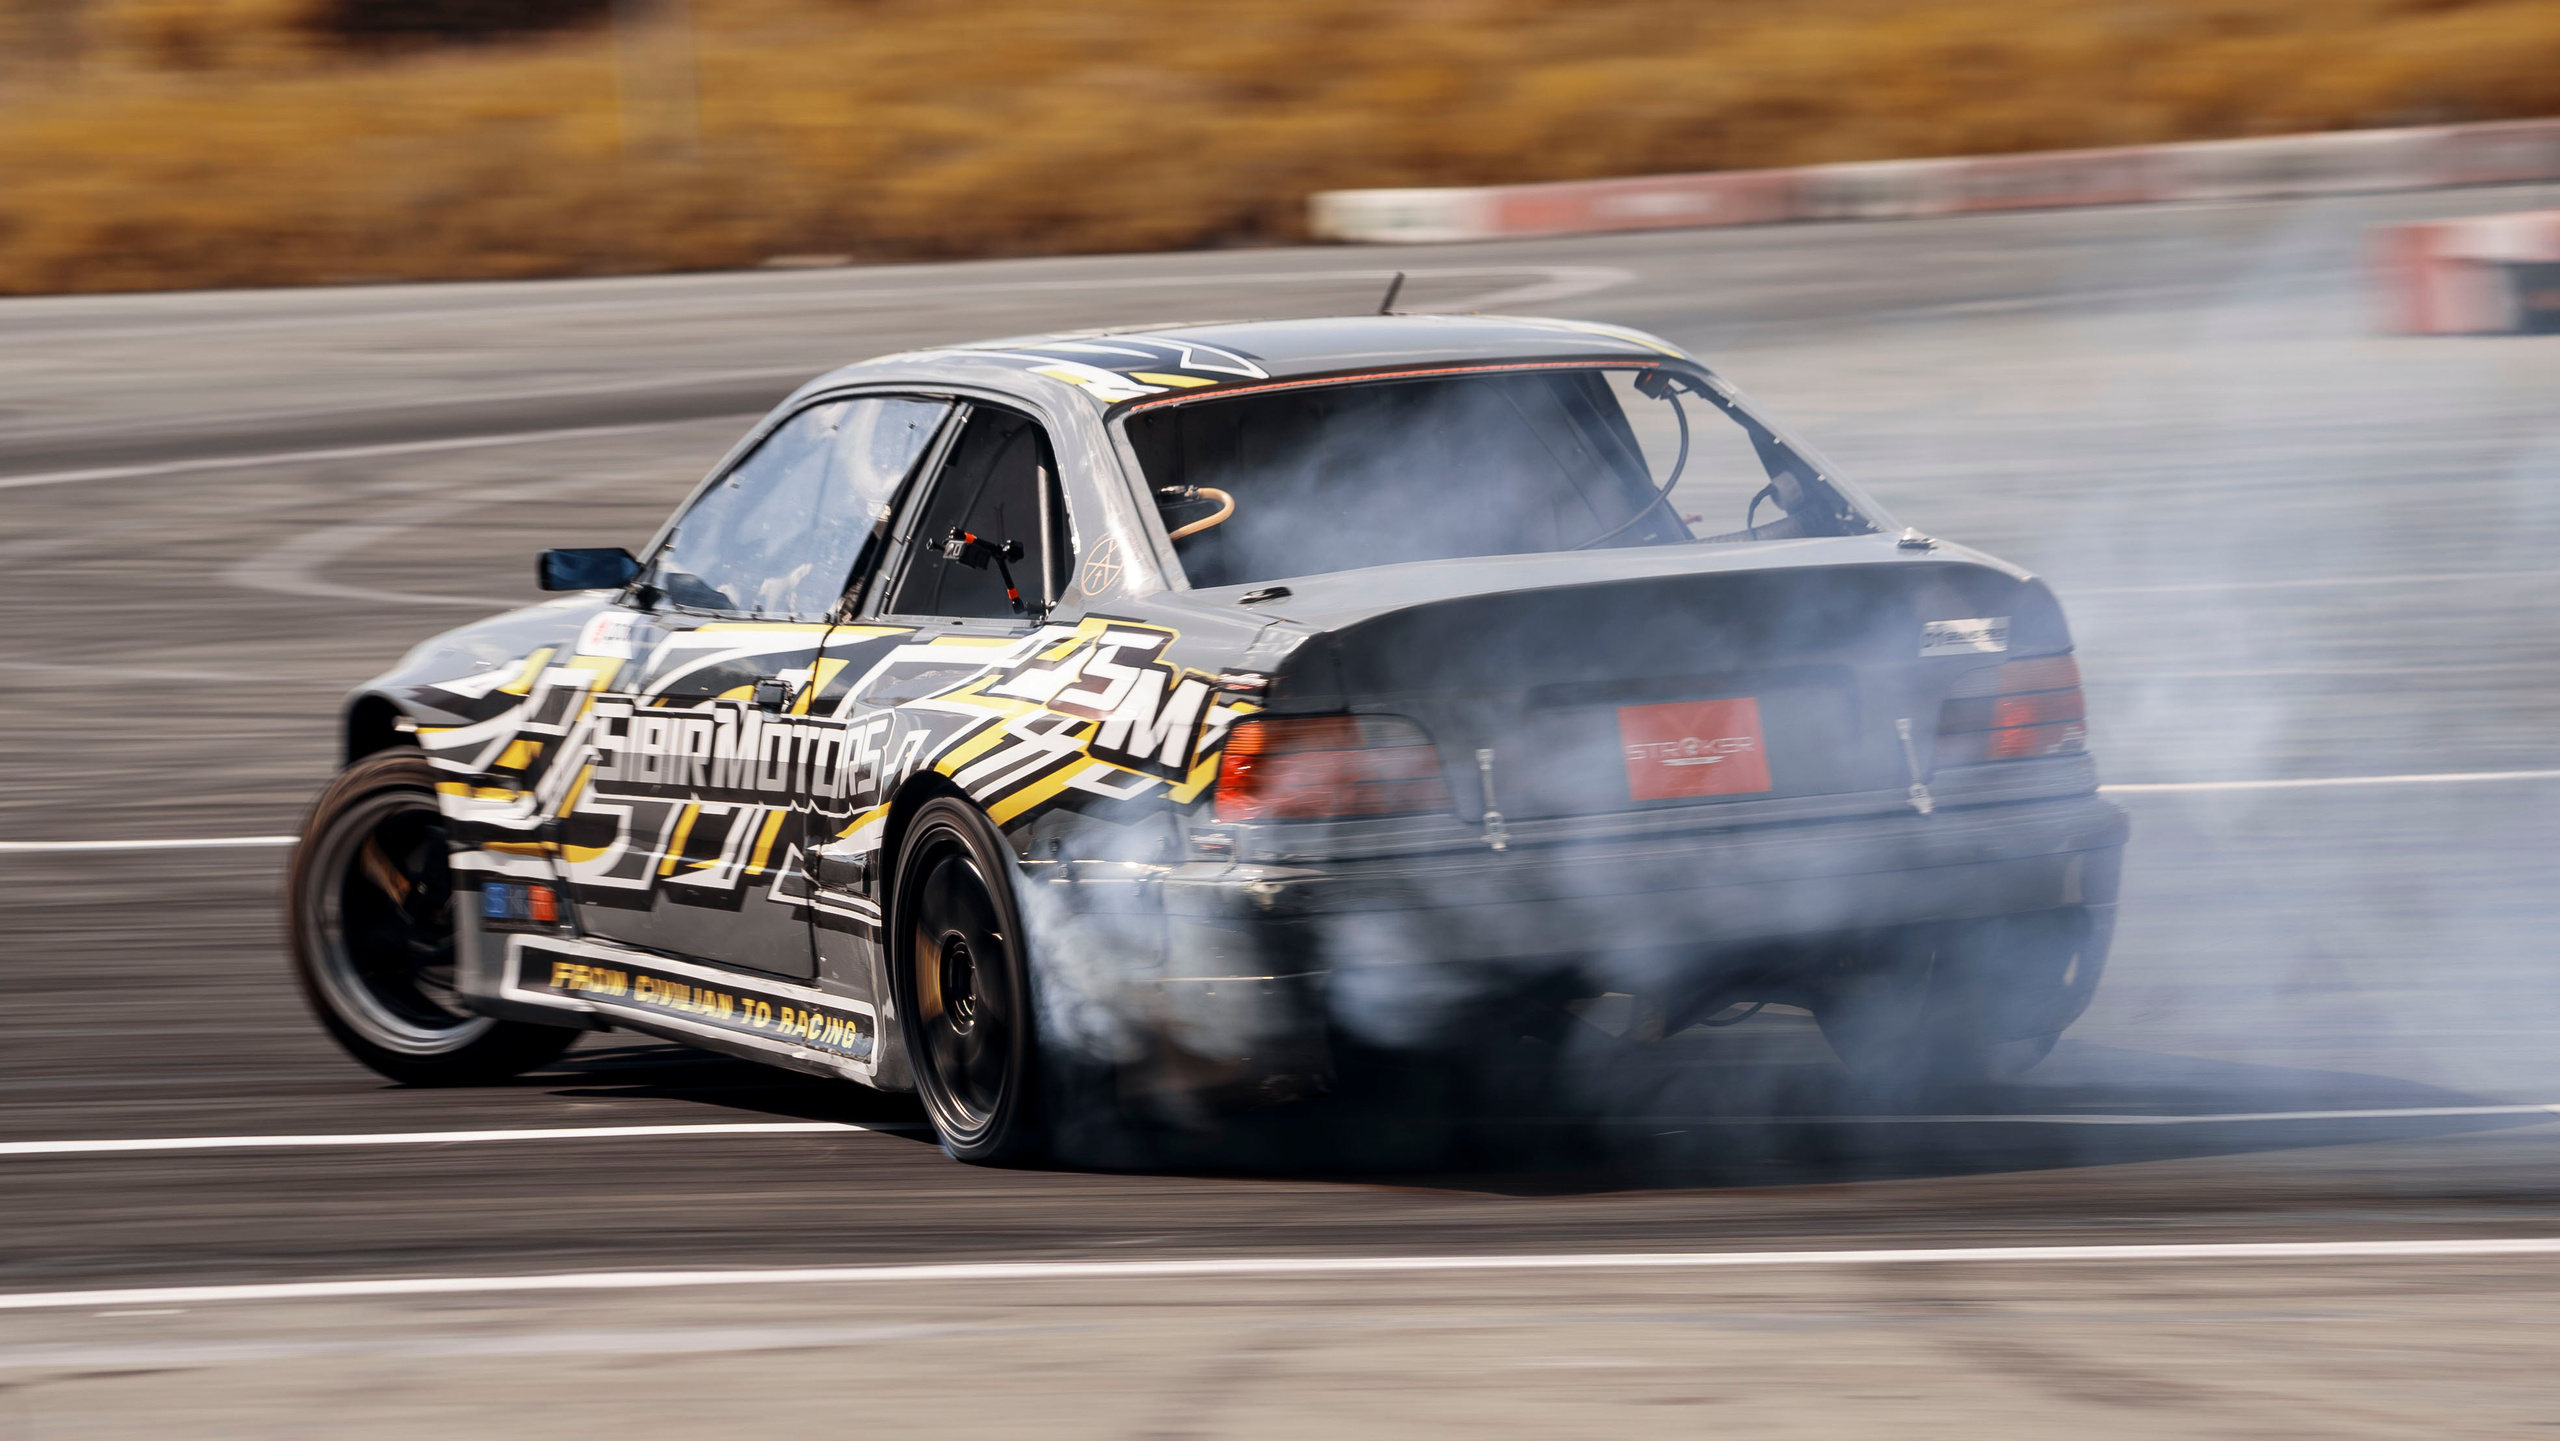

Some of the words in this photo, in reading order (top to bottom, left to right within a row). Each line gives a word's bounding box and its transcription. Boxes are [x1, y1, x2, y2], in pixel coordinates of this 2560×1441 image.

[1054, 631, 1210, 768] SM
[550, 961, 628, 996] FROM
[634, 975, 734, 1020] CIVILIAN
[741, 998, 772, 1028] TO
[776, 1006, 857, 1049] RACING
